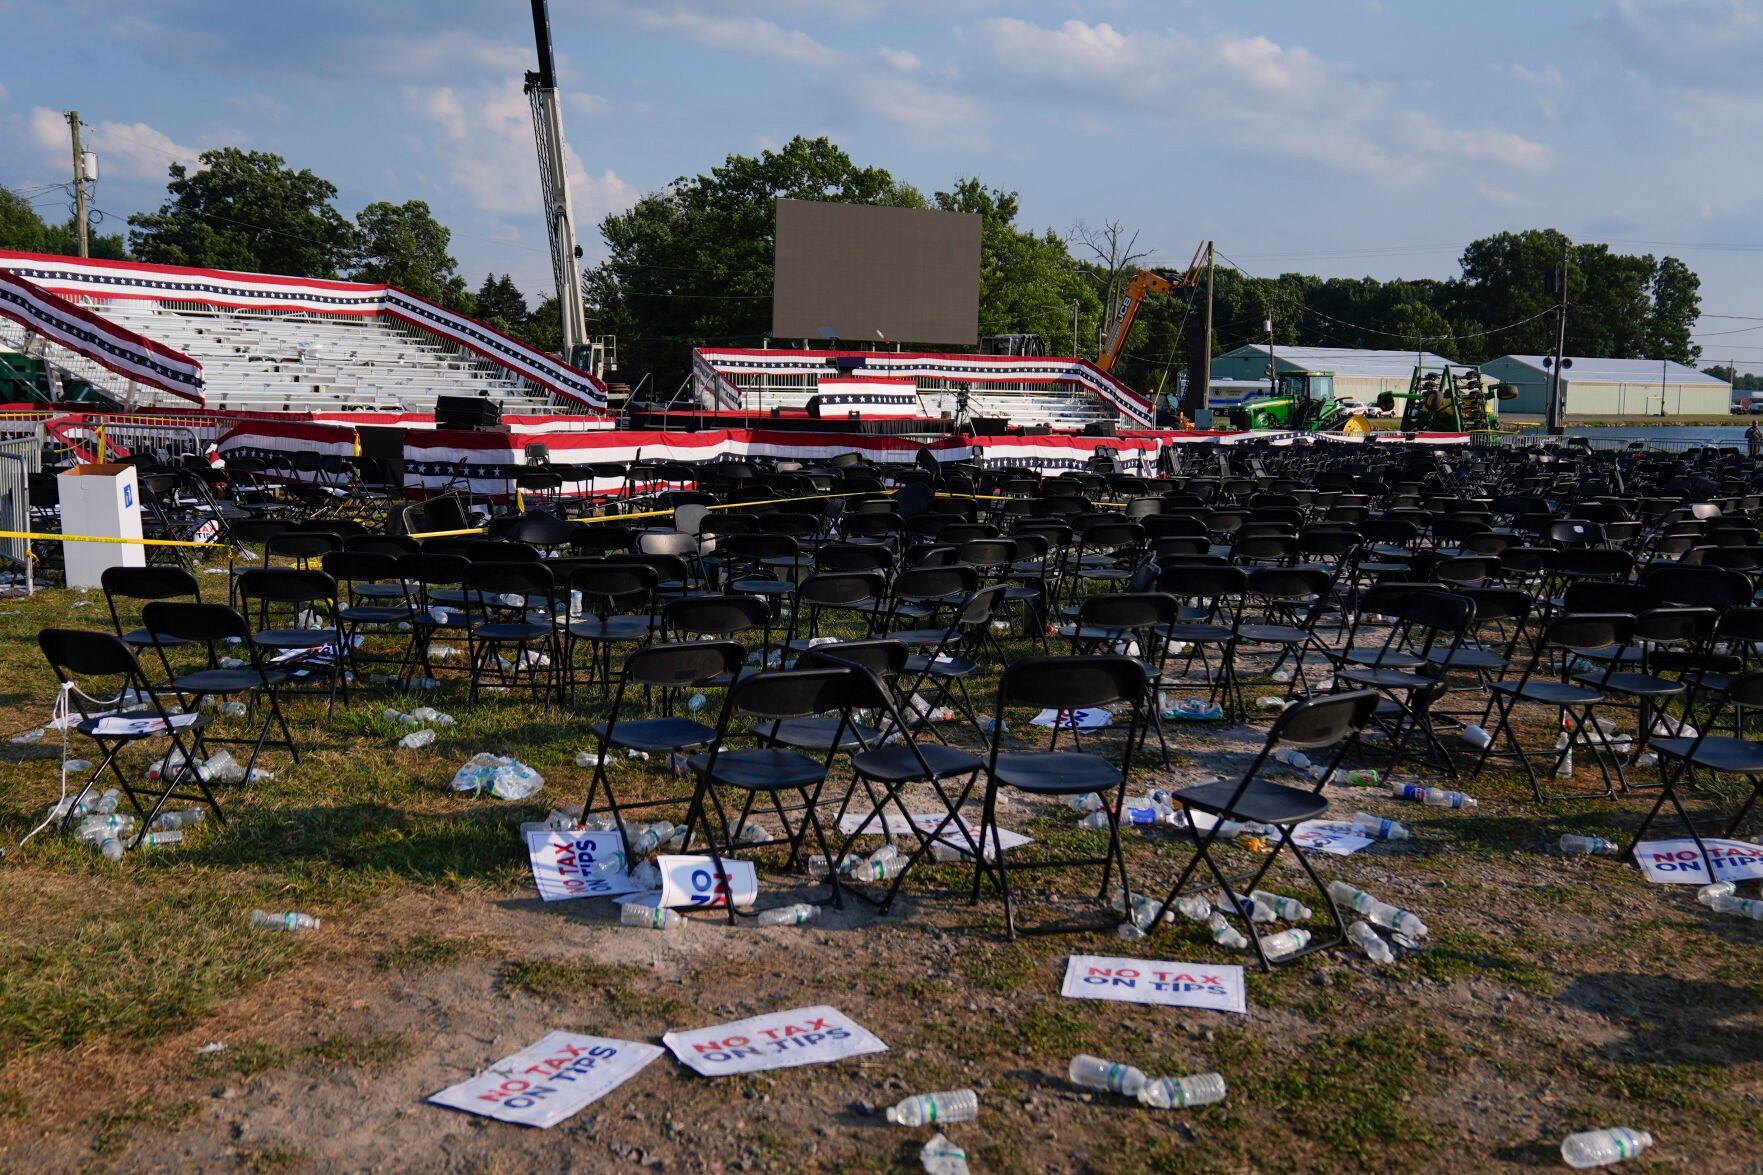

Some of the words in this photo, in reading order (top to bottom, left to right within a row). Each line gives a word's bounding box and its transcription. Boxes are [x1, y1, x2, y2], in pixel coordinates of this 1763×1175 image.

[1118, 297, 1132, 322] JCB
[1065, 711, 1089, 727] ON
[554, 842, 579, 875] TAX
[576, 840, 597, 877] TIPS
[1653, 850, 1698, 862] NO
[1707, 848, 1763, 858] TAX
[1655, 861, 1701, 871] ON
[563, 879, 588, 894] NO
[586, 879, 612, 891] ON
[1083, 976, 1136, 988] ON
[1150, 982, 1228, 995] TIPS
[1088, 967, 1140, 978] NO
[1152, 971, 1221, 985] TAX
[692, 1035, 750, 1053] NO
[757, 1017, 833, 1040] TAX
[702, 1046, 762, 1062] ON
[766, 1027, 851, 1051] TIPS
[477, 1079, 530, 1102] NO
[524, 1043, 589, 1075] TAX
[503, 1086, 558, 1108] ON
[548, 1046, 617, 1082] TIPS
